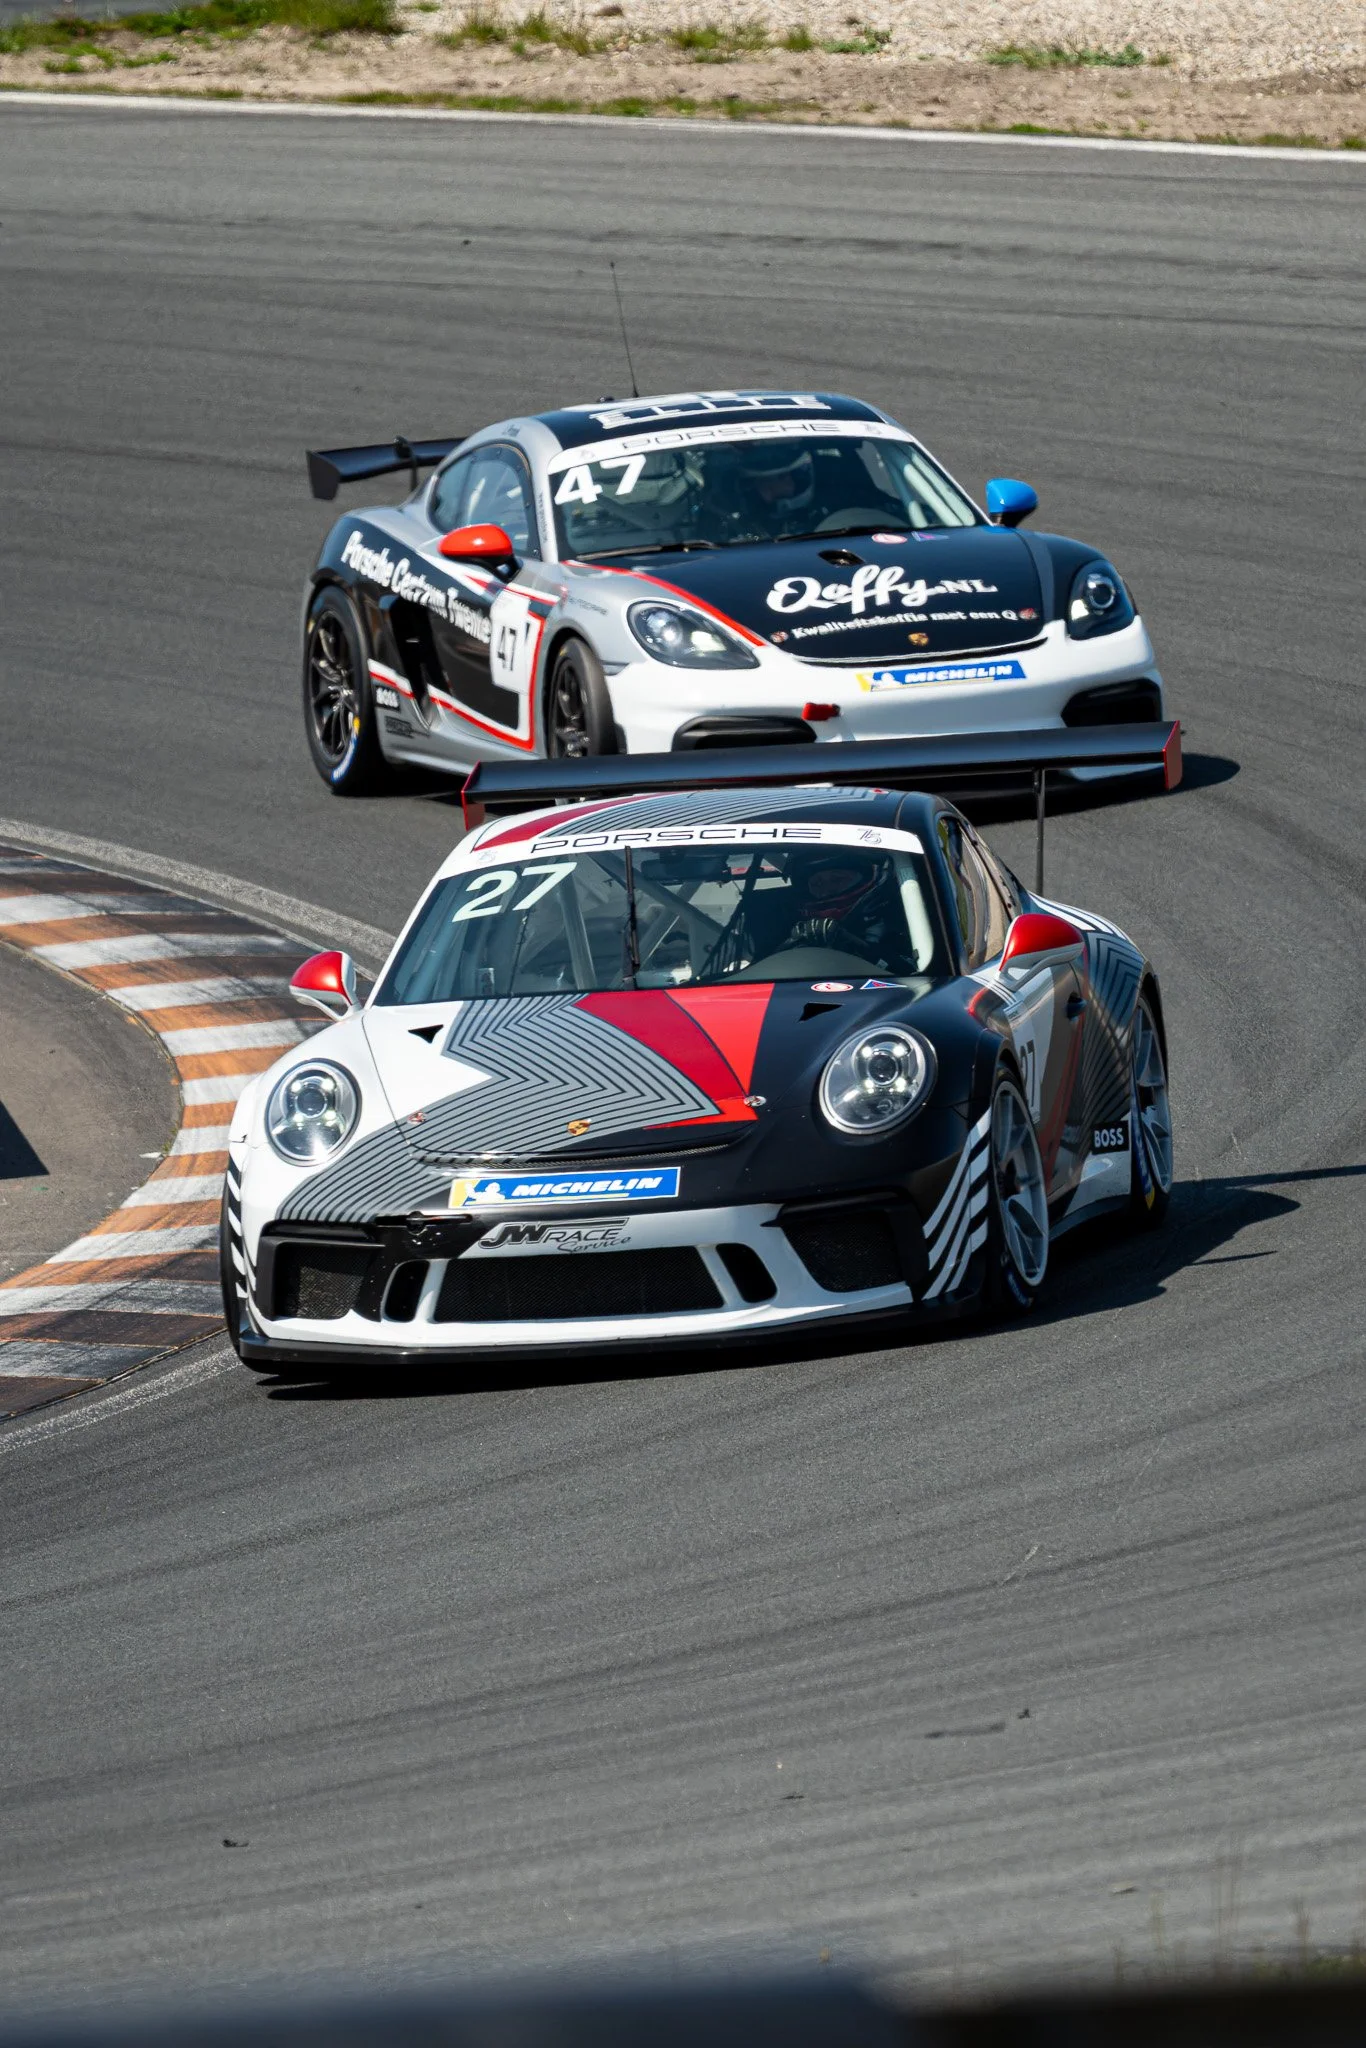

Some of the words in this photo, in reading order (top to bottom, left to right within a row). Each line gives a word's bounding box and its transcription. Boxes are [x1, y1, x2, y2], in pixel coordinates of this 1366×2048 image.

[621, 422, 840, 450] PORSCHE
[553, 453, 647, 505] 47
[340, 530, 394, 588] Porsche
[1001, 609, 1018, 621] Q
[498, 625, 517, 672] 47
[904, 664, 1013, 684] MICHELIN
[530, 828, 822, 854] PORSCHE
[451, 861, 578, 923] 27
[1093, 1127, 1124, 1149] BOSS
[511, 1176, 663, 1197] MICHELIN
